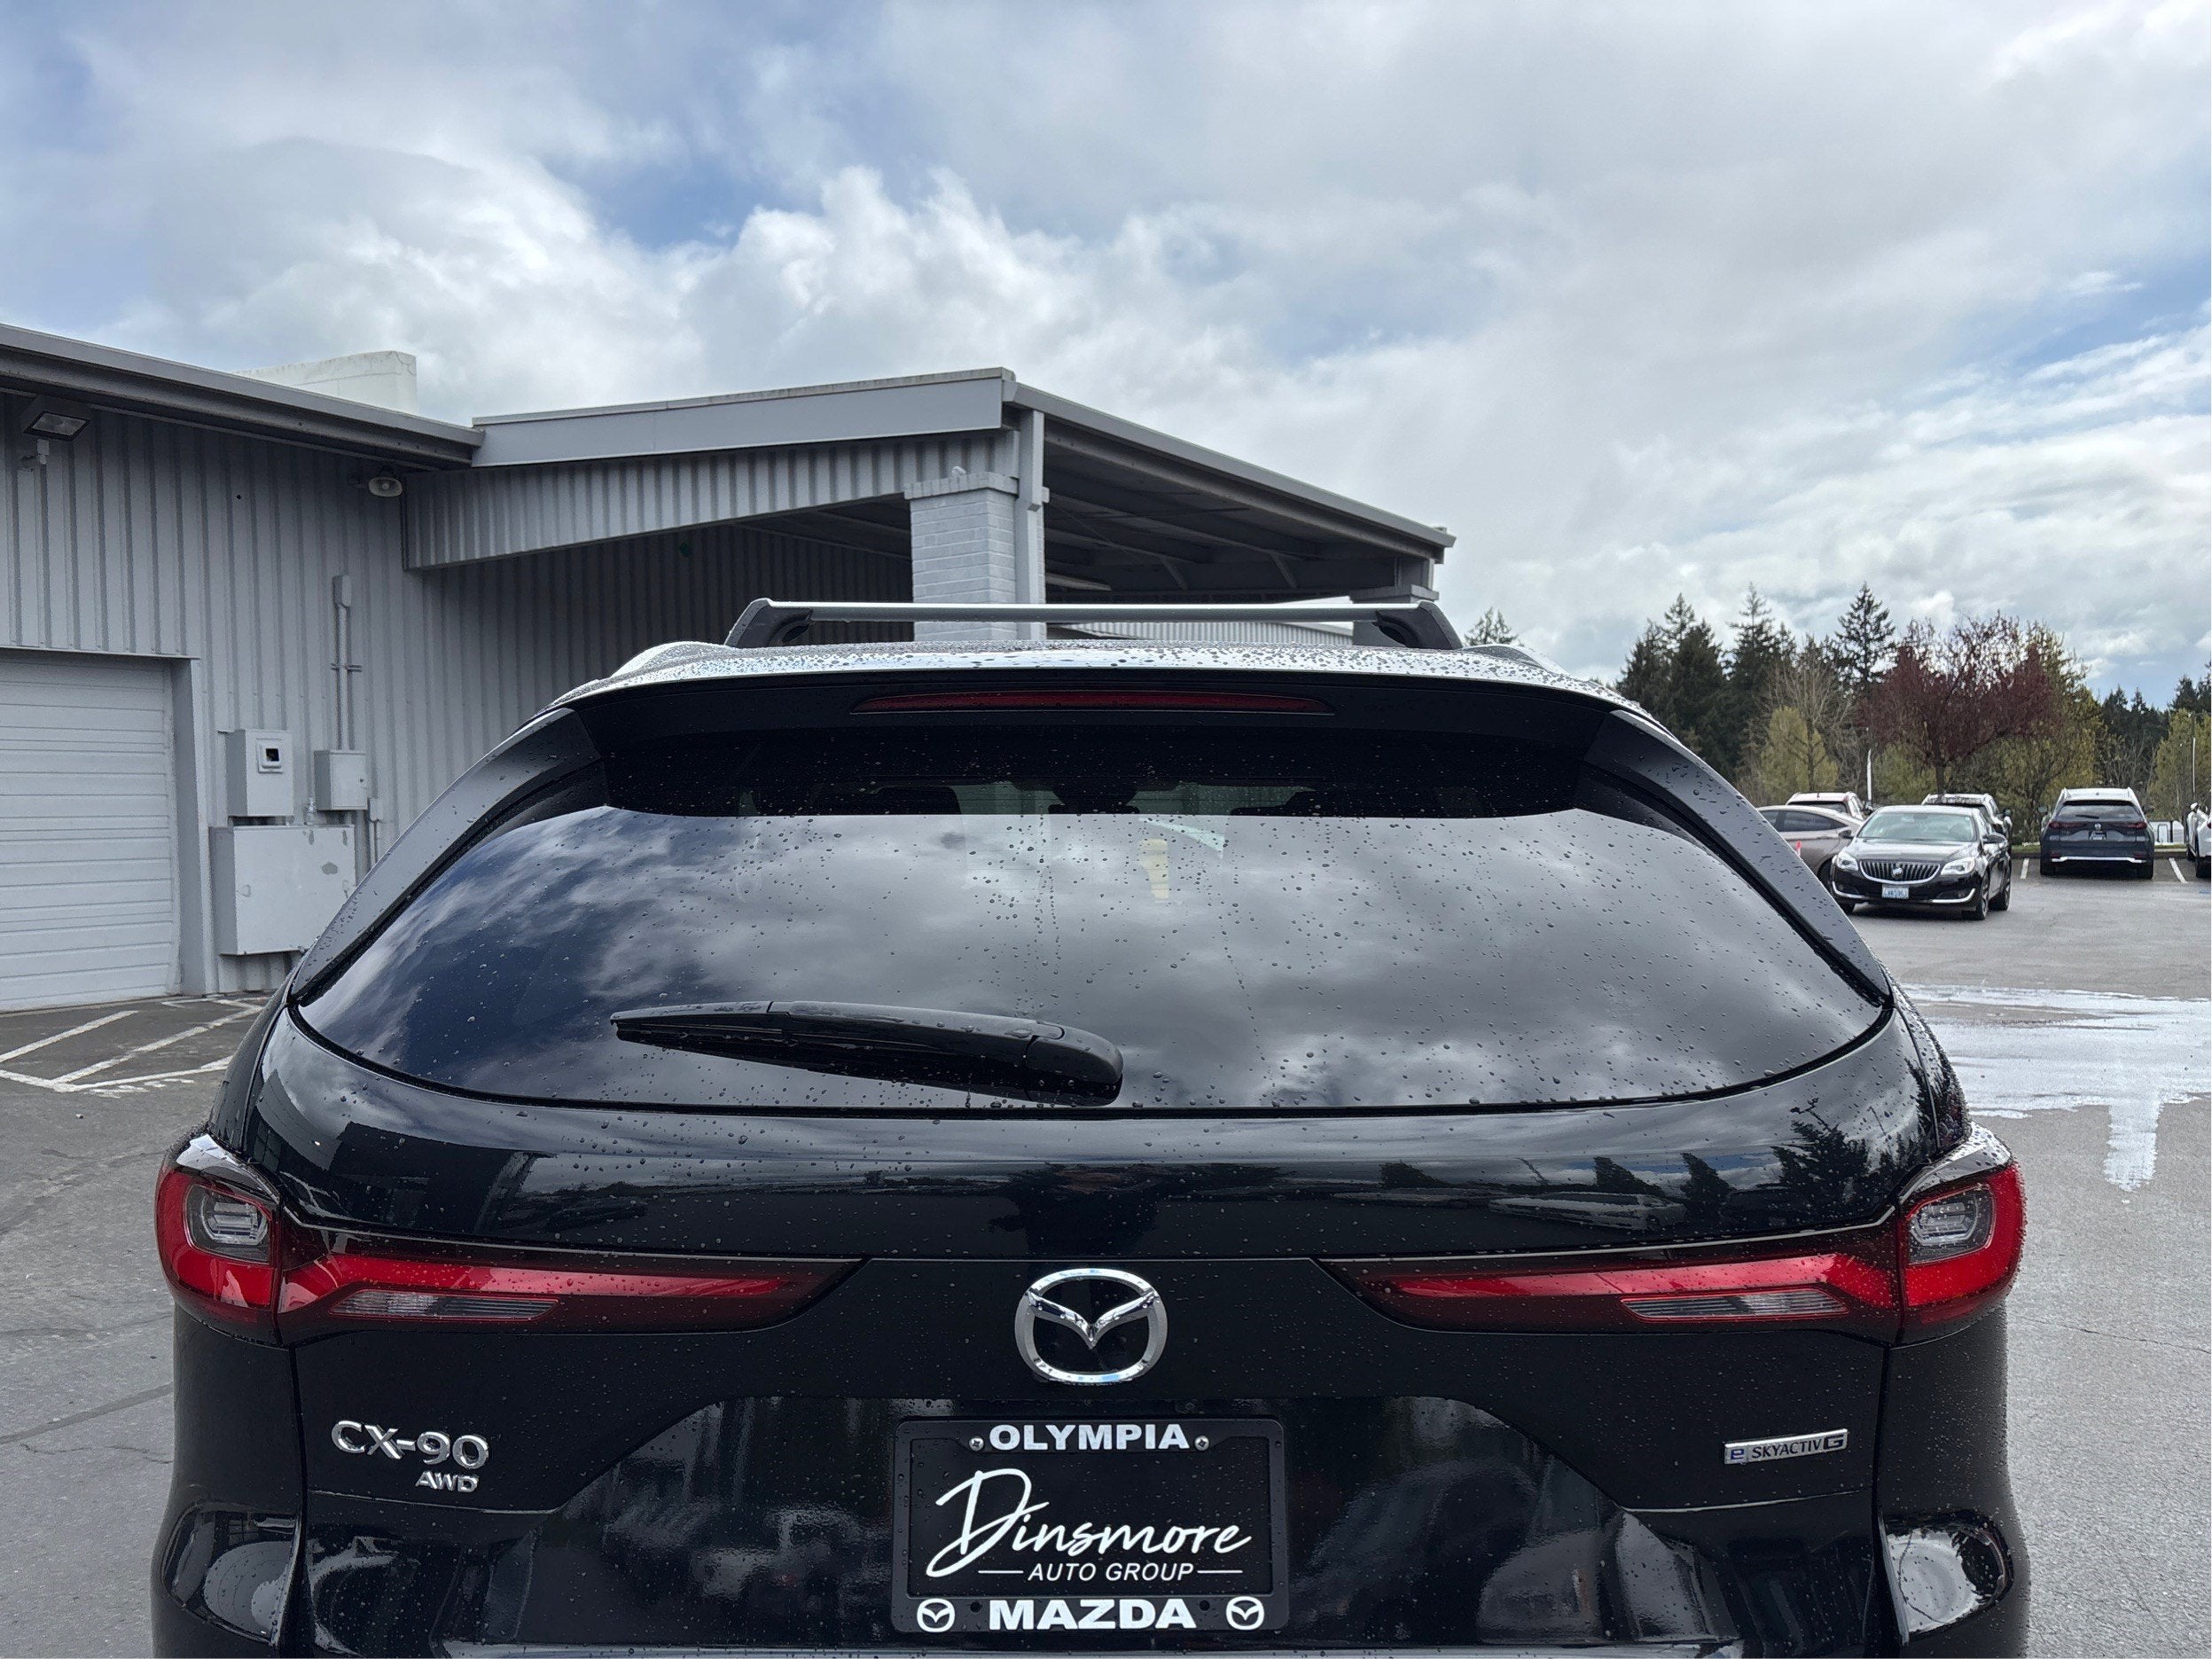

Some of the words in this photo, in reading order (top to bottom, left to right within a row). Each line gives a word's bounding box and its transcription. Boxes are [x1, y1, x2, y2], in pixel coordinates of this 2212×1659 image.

[332, 1420, 489, 1470] CX-90
[989, 1424, 1190, 1451] OLYMPIA
[415, 1470, 479, 1493] AWD
[925, 1467, 1253, 1578] Dinsmore
[1028, 1562, 1097, 1582] AUTO
[1105, 1562, 1194, 1582] GROUP
[989, 1599, 1197, 1631] MAZDA
